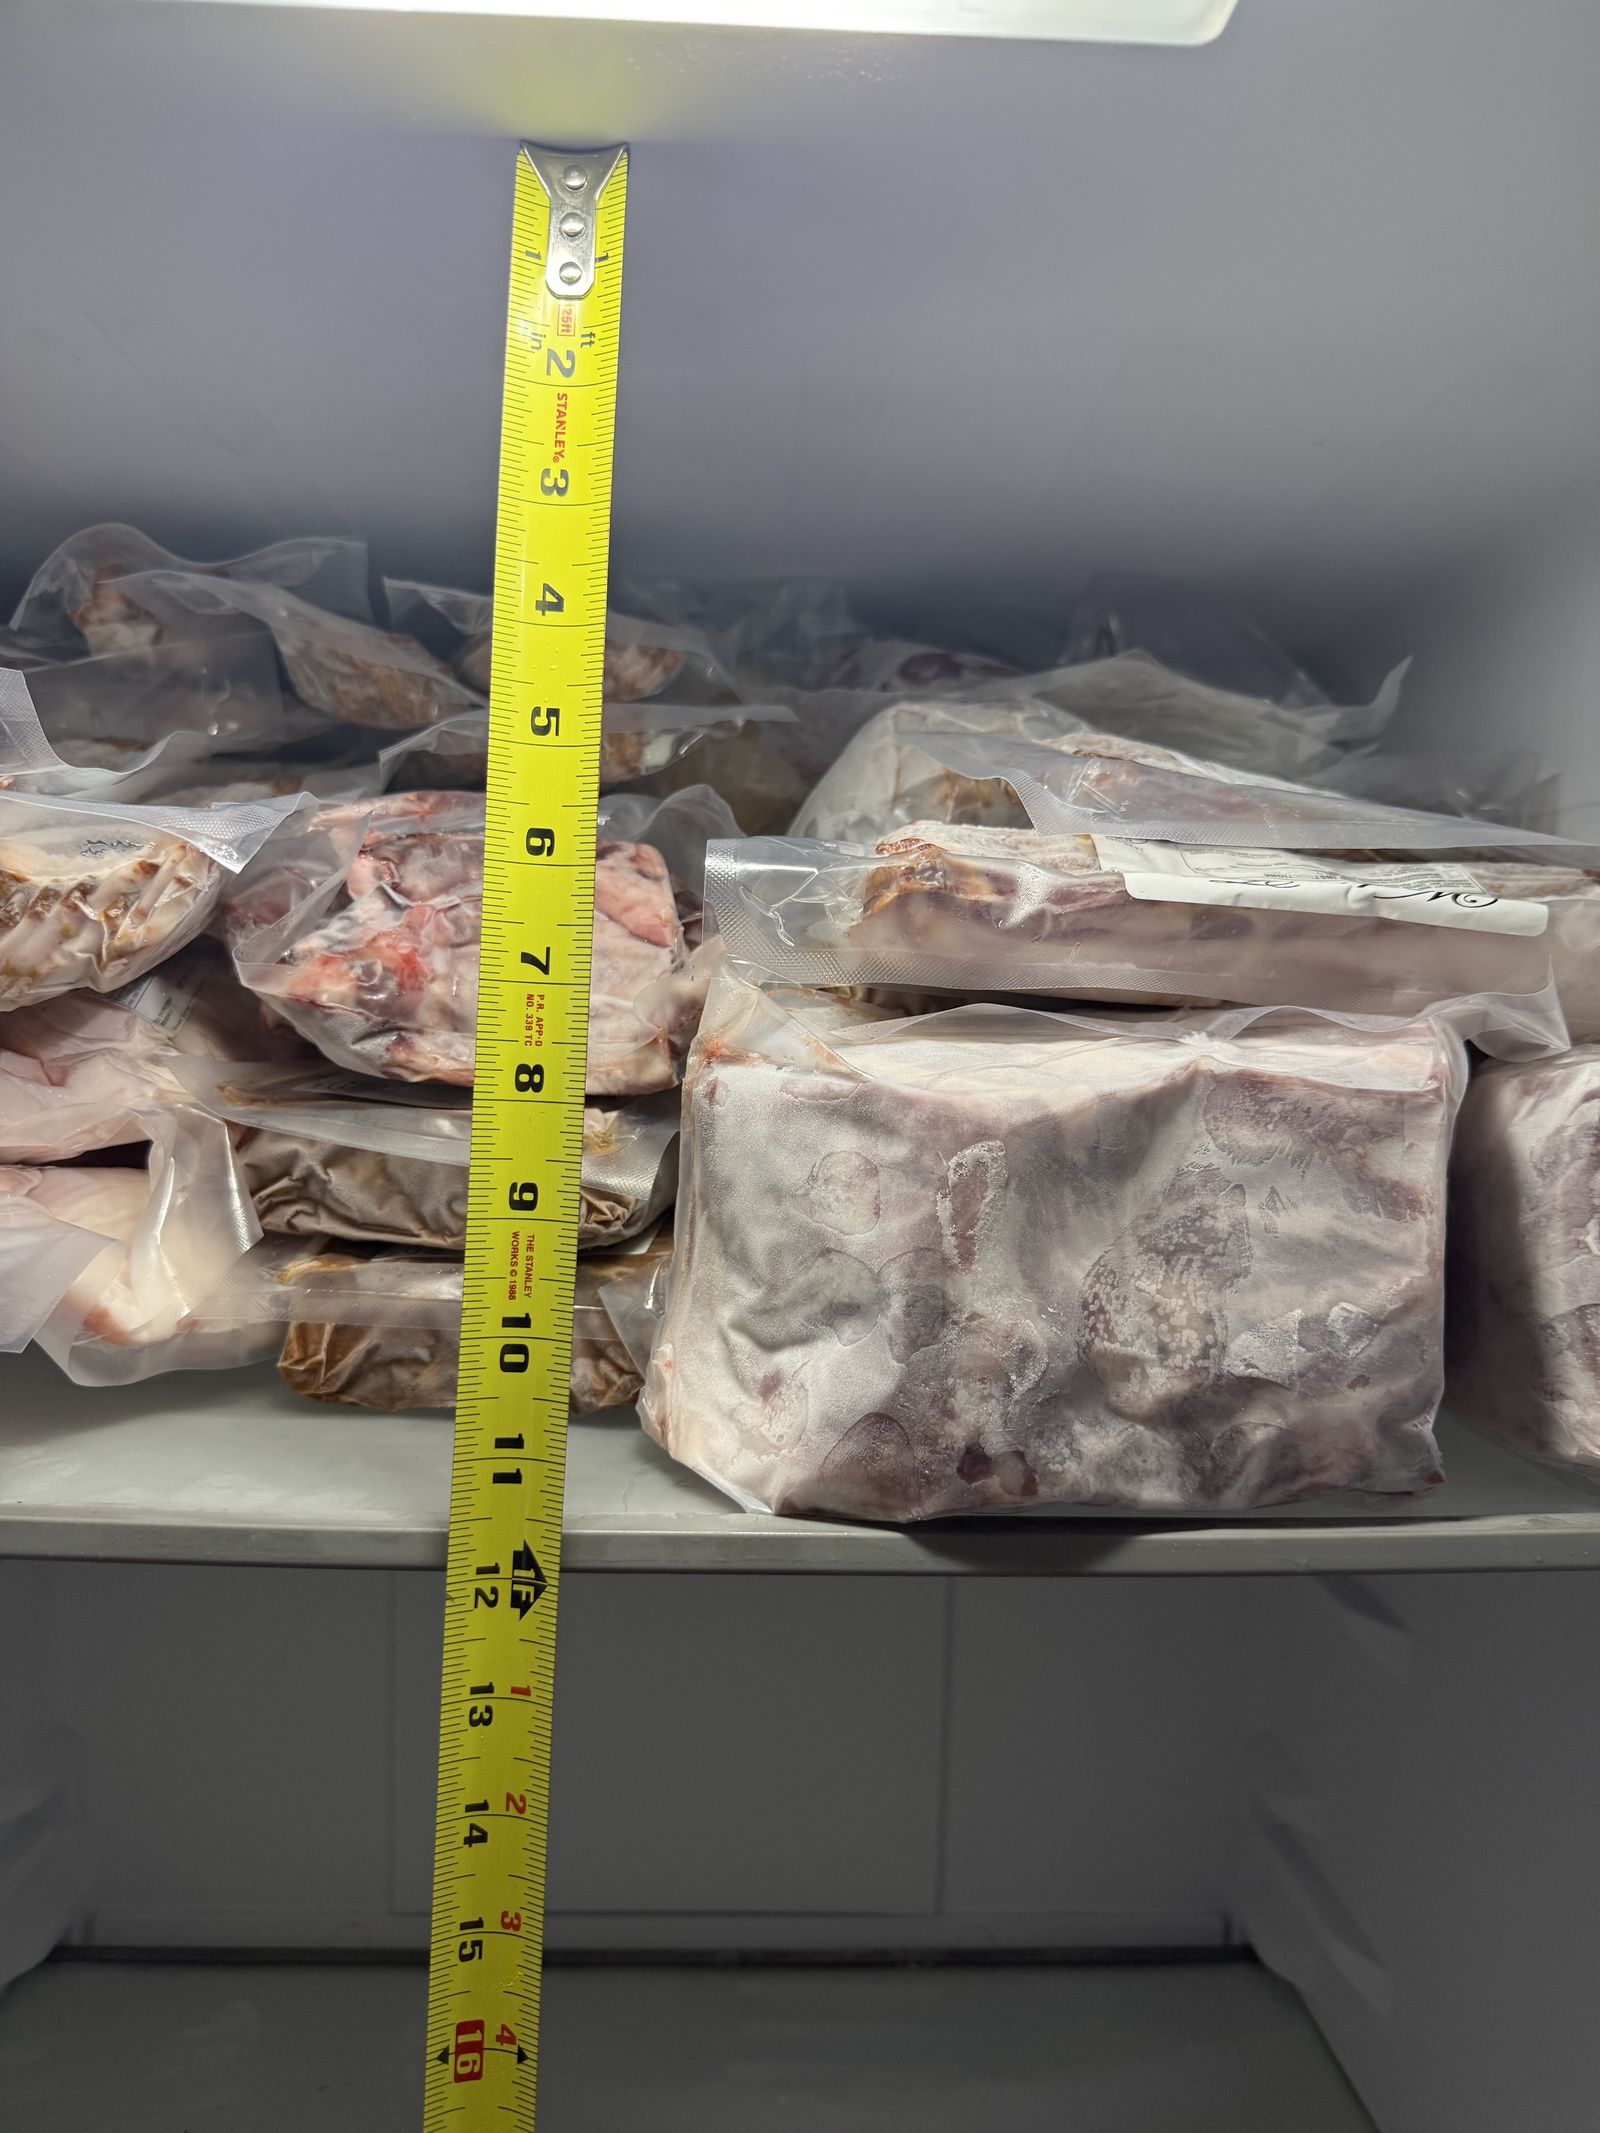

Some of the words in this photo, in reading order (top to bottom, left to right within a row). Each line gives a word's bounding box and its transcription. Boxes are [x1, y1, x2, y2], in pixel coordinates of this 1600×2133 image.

[525, 250, 542, 260] 1
[595, 252, 609, 262] 1
[530, 331, 546, 350] in
[580, 331, 596, 348] ft
[546, 348, 576, 378] 2
[540, 467, 569, 497] 3
[535, 582, 565, 616] 4
[530, 706, 560, 737] 5
[525, 827, 555, 857] 6
[520, 946, 550, 975] 7
[525, 1012, 534, 1032] 339
[524, 1034, 533, 1047] TC
[514, 1063, 545, 1093] 8
[508, 1182, 539, 1212] 9
[510, 1231, 520, 1267] WORKS
[526, 1234, 535, 1252] THE
[508, 1279, 517, 1301] 1988
[524, 1254, 534, 1299] STANLEY
[500, 1312, 532, 1373] 10
[492, 1433, 524, 1484] 11
[474, 1562, 500, 1609] 12
[512, 1567, 536, 1604] 1F
[469, 1682, 495, 1727] 13
[510, 1685, 532, 1697] 1
[505, 1792, 527, 1815] 2
[463, 1799, 489, 1848] 14
[501, 1910, 521, 1932] 3
[458, 1917, 484, 1963] 15
[495, 2023, 517, 2046] 4
[456, 2029, 482, 2075] 16
